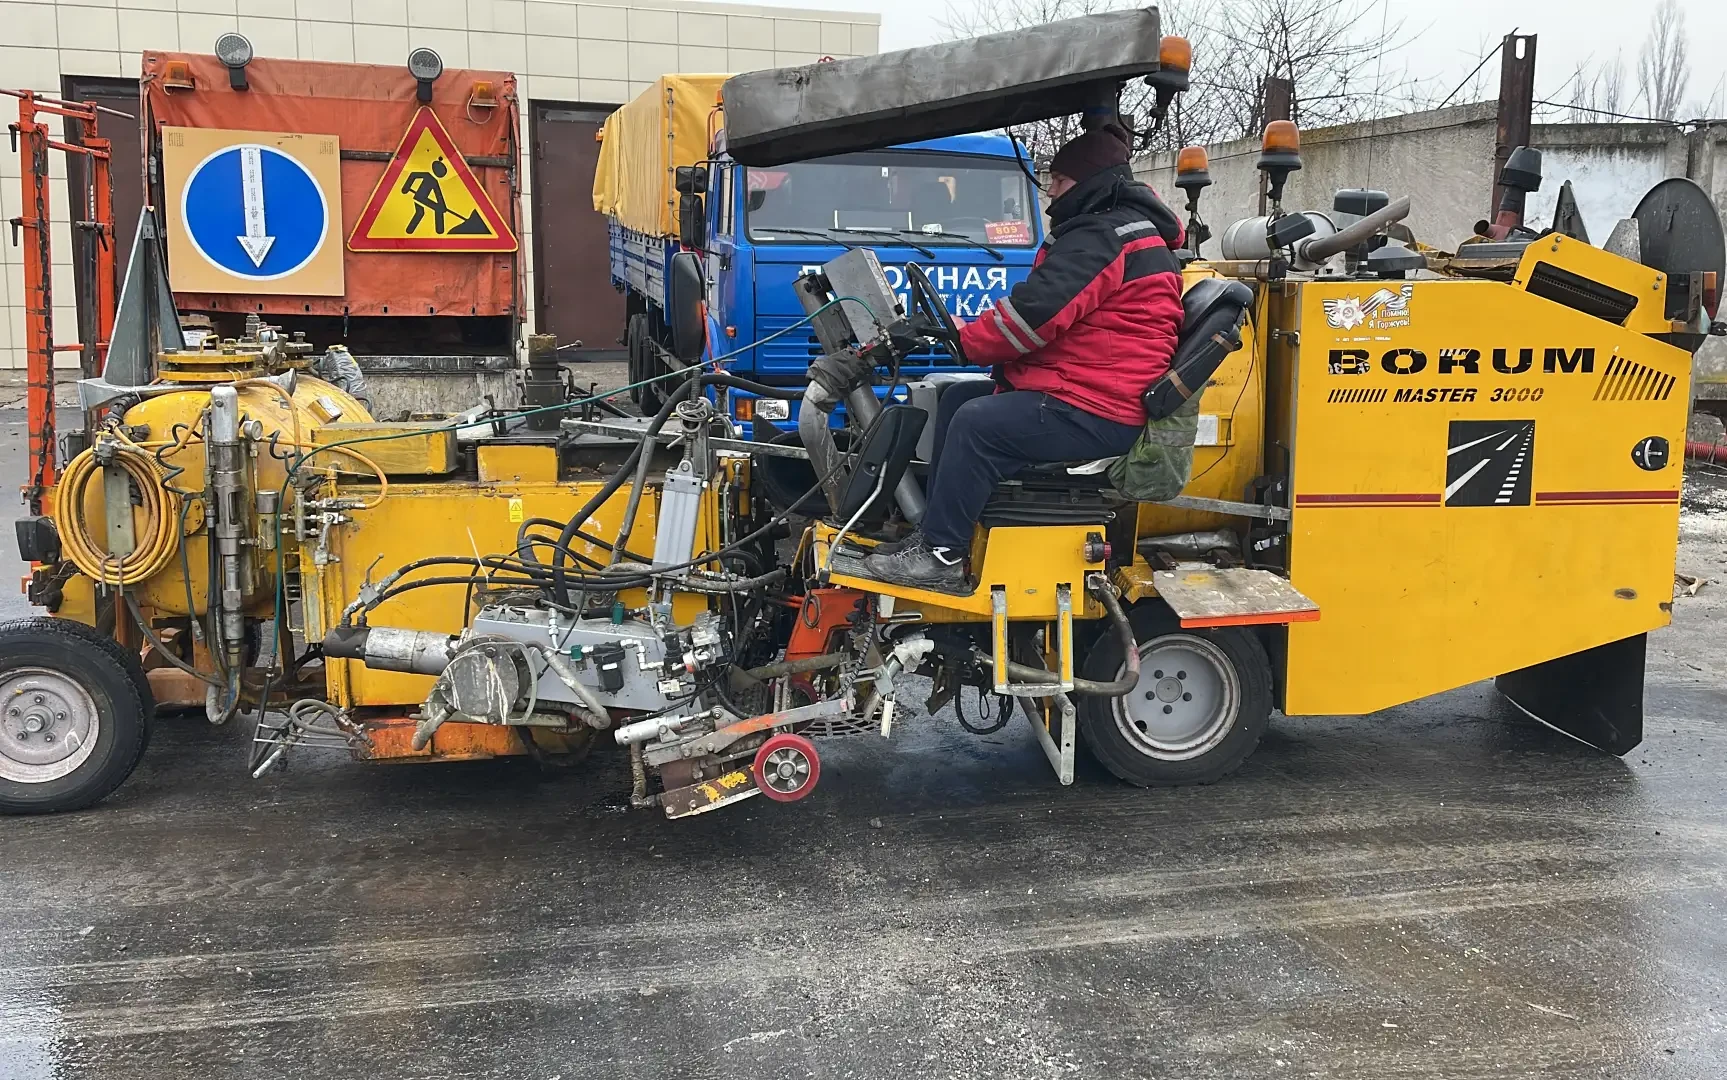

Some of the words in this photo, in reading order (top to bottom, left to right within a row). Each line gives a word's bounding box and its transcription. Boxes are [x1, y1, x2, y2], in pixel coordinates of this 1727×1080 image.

[995, 226, 1018, 235] 809
[1372, 310, 1378, 319] Я
[1369, 321, 1375, 329] Я
[1328, 348, 1596, 375] BORUM
[1393, 388, 1479, 403] MASTER
[1490, 388, 1545, 403] 3000
